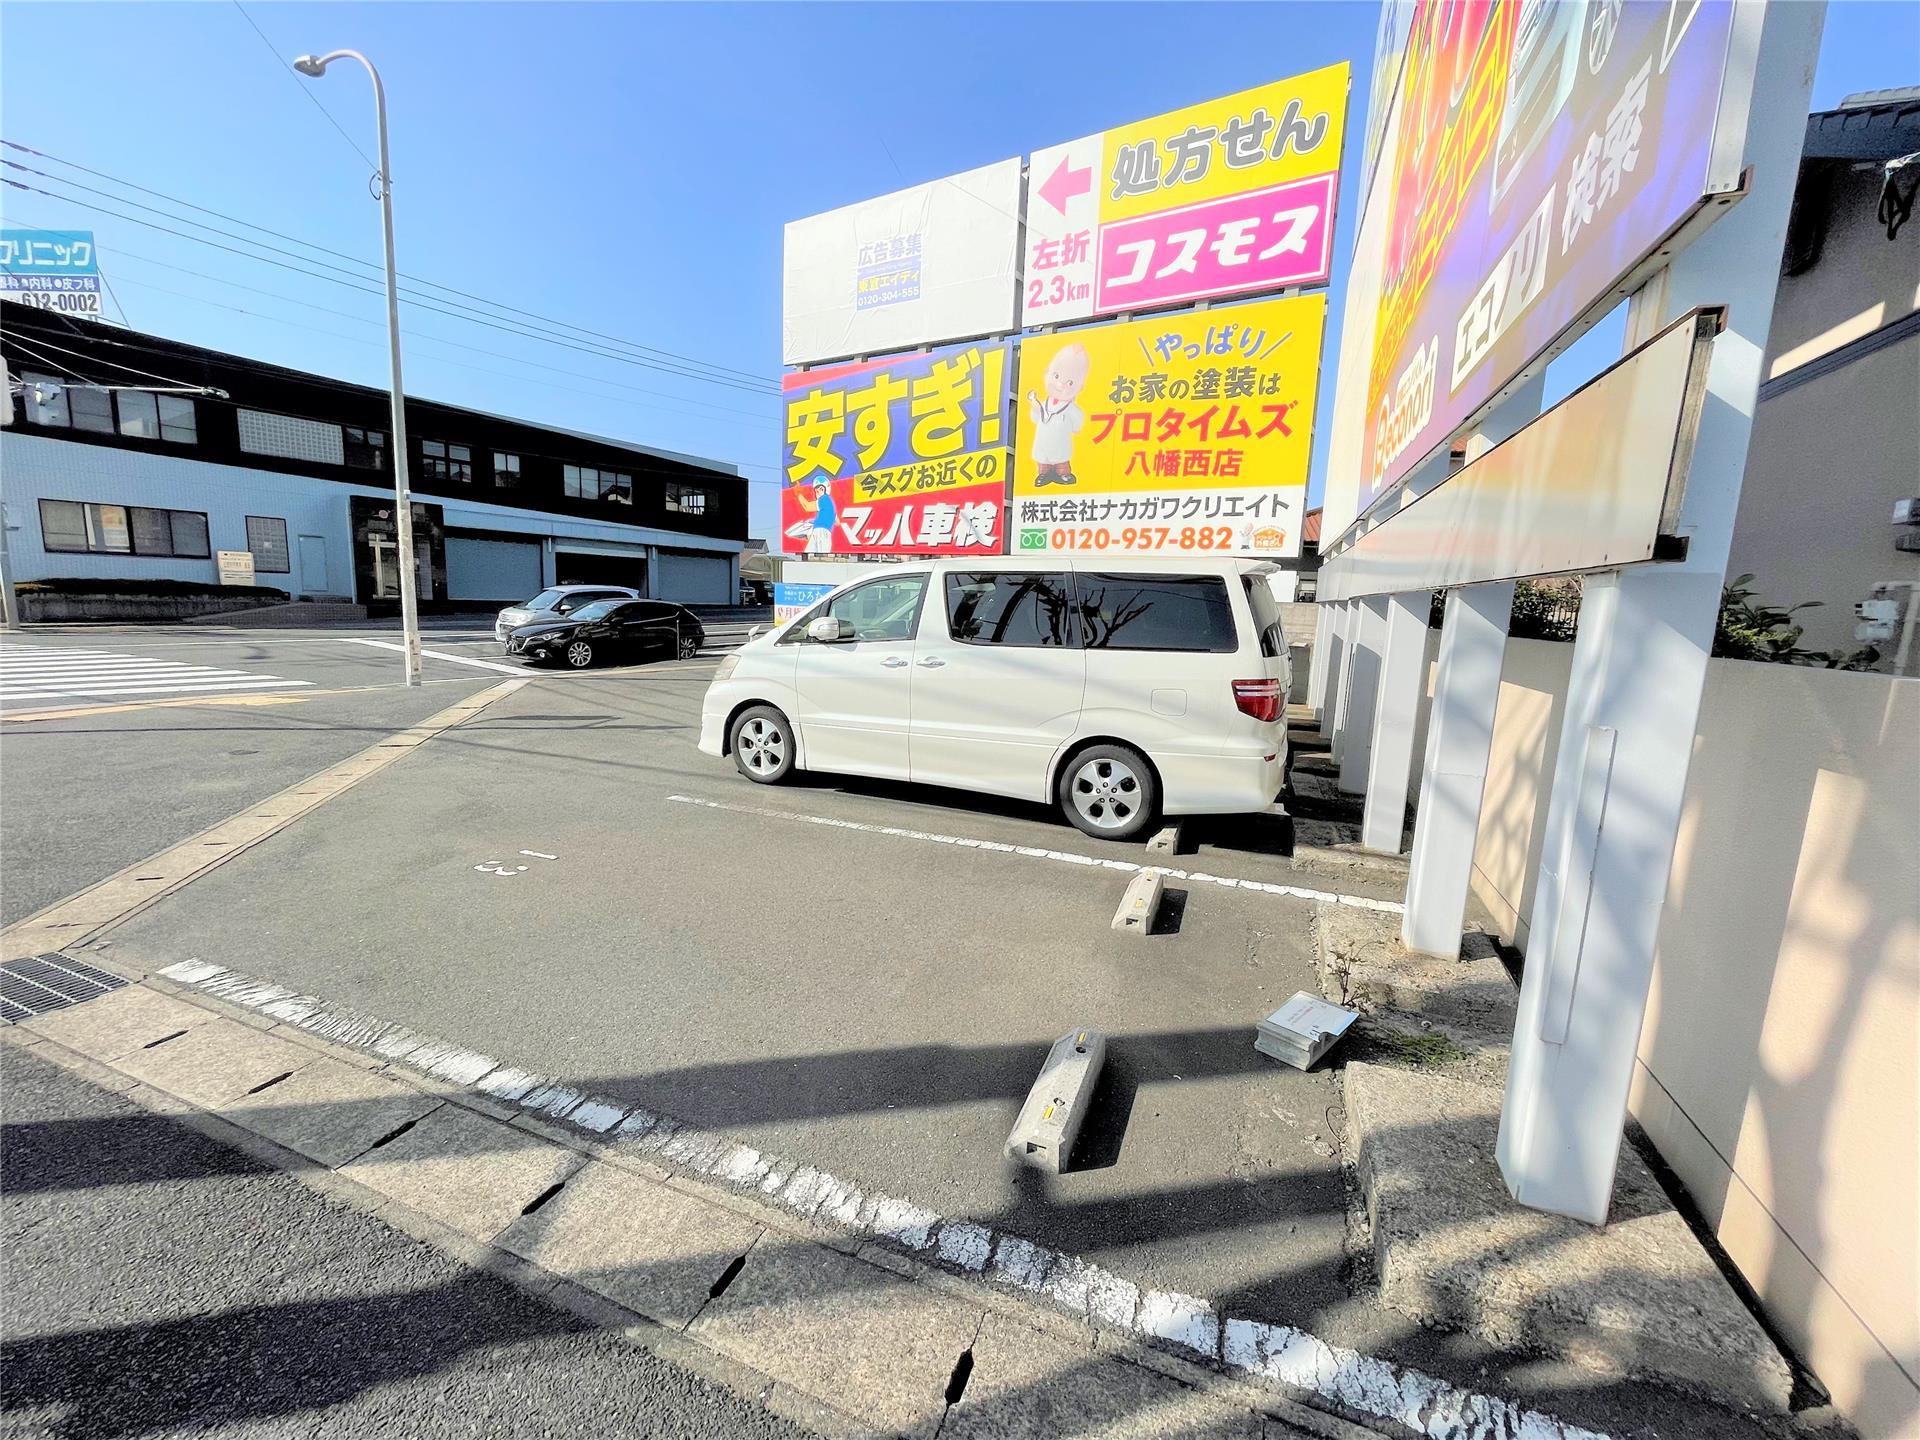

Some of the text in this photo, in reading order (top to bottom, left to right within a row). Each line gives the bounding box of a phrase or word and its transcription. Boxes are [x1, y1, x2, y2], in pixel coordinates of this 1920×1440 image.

[1111, 98, 1330, 201] 処方せん
[1562, 54, 1652, 256] 検索
[857, 233, 921, 267] 広告募集
[1032, 229, 1091, 271] 左折
[1106, 205, 1320, 288] コスモス
[1028, 275, 1090, 308] 2.3km
[1457, 209, 1545, 374] エコノリ
[1154, 323, 1267, 362] やっぱり
[1109, 366, 1281, 404] お家の塗装は
[787, 348, 1005, 484] 安すぎ!
[1090, 400, 1300, 444] プロタイムズ
[860, 455, 998, 498] 今スグお近くの
[1125, 449, 1244, 478] 八幡西店
[841, 501, 1000, 547] マッハ車検
[1021, 493, 1290, 523] 株式会社ナカガワクリエイト
[1051, 526, 1234, 550] 0120-957-882
